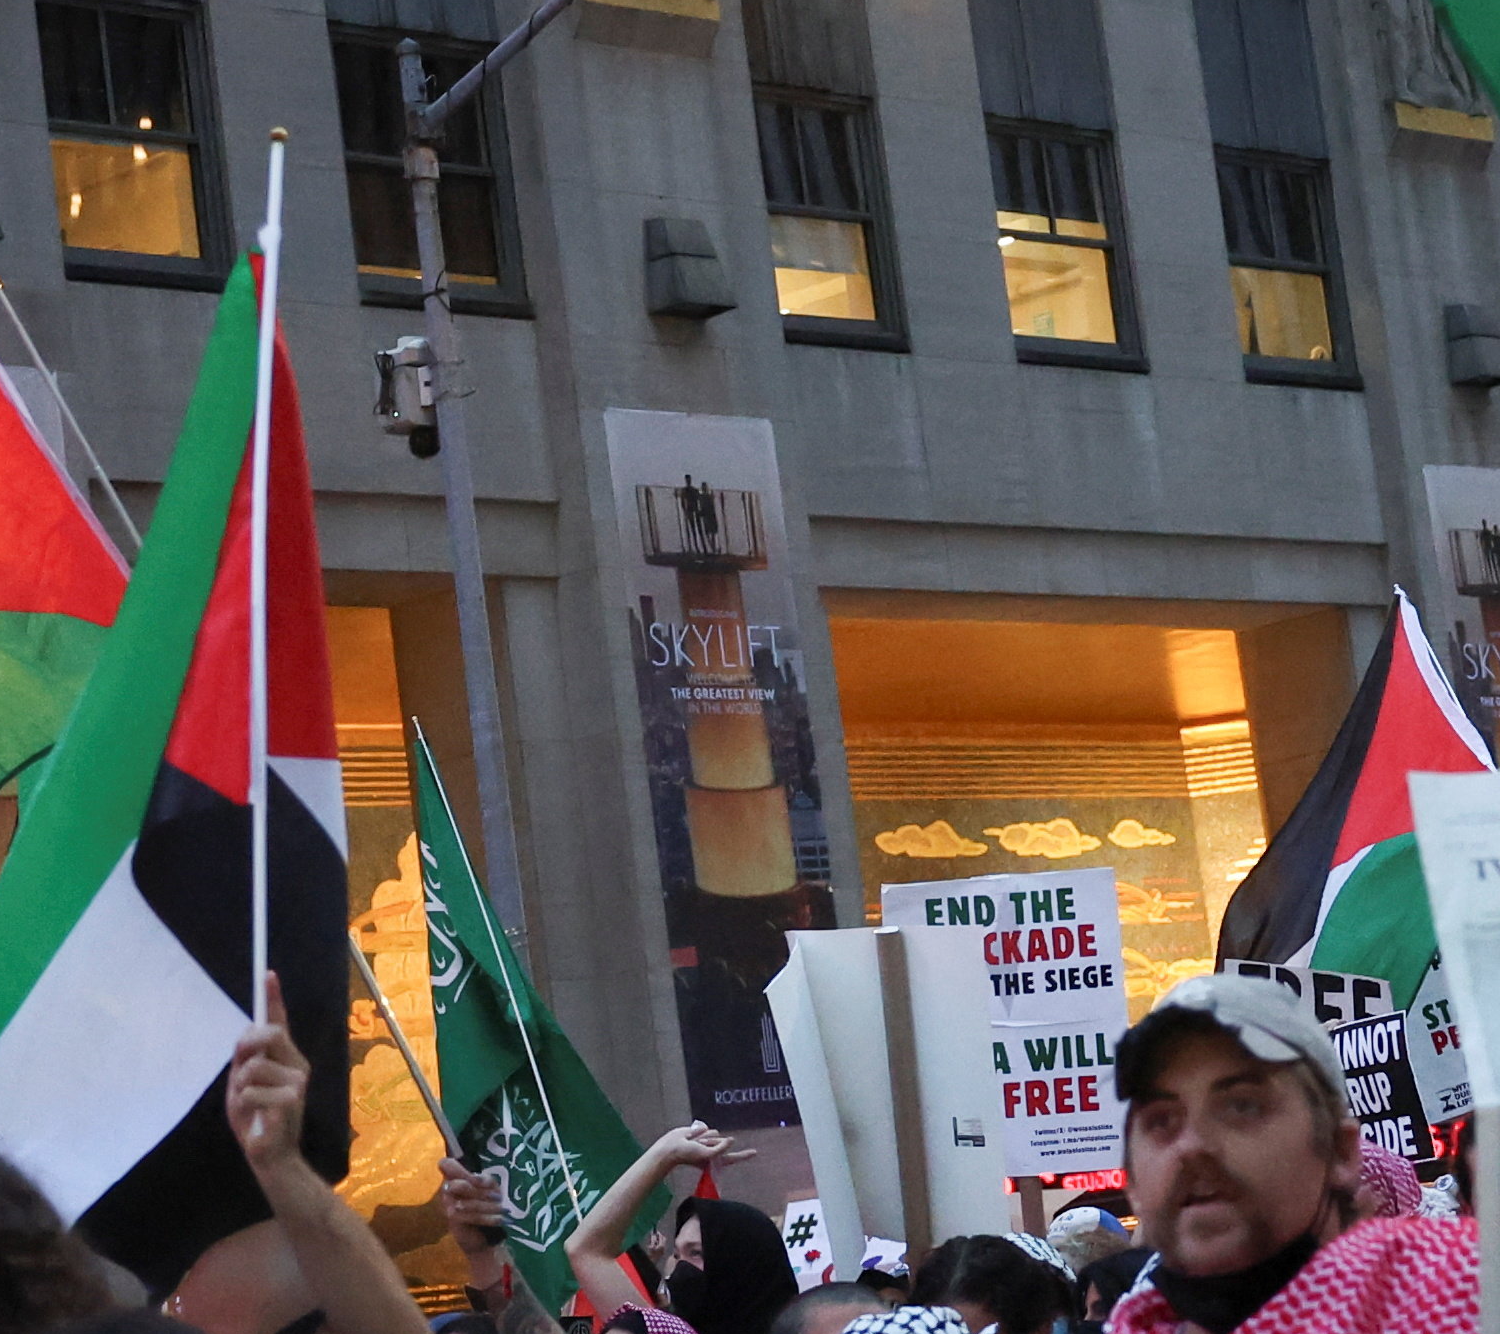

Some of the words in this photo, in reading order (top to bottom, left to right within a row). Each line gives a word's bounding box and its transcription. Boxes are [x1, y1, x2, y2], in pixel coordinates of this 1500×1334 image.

[650, 623, 780, 668] SKYLIFT
[671, 687, 692, 700] THE
[693, 687, 745, 700] GREATEST
[748, 688, 775, 700] VIEW
[925, 895, 996, 927] END
[1009, 887, 1077, 925] THE
[983, 924, 1098, 966] CKADE
[990, 972, 1036, 997] THE
[1045, 964, 1114, 993] SIEGE
[1024, 1033, 1114, 1072] WILL
[1334, 1020, 1401, 1071] ANNOT
[715, 1086, 793, 1104] ROCKEFELLER
[1003, 1075, 1100, 1118] FREE
[1360, 1116, 1418, 1157] CIDE
